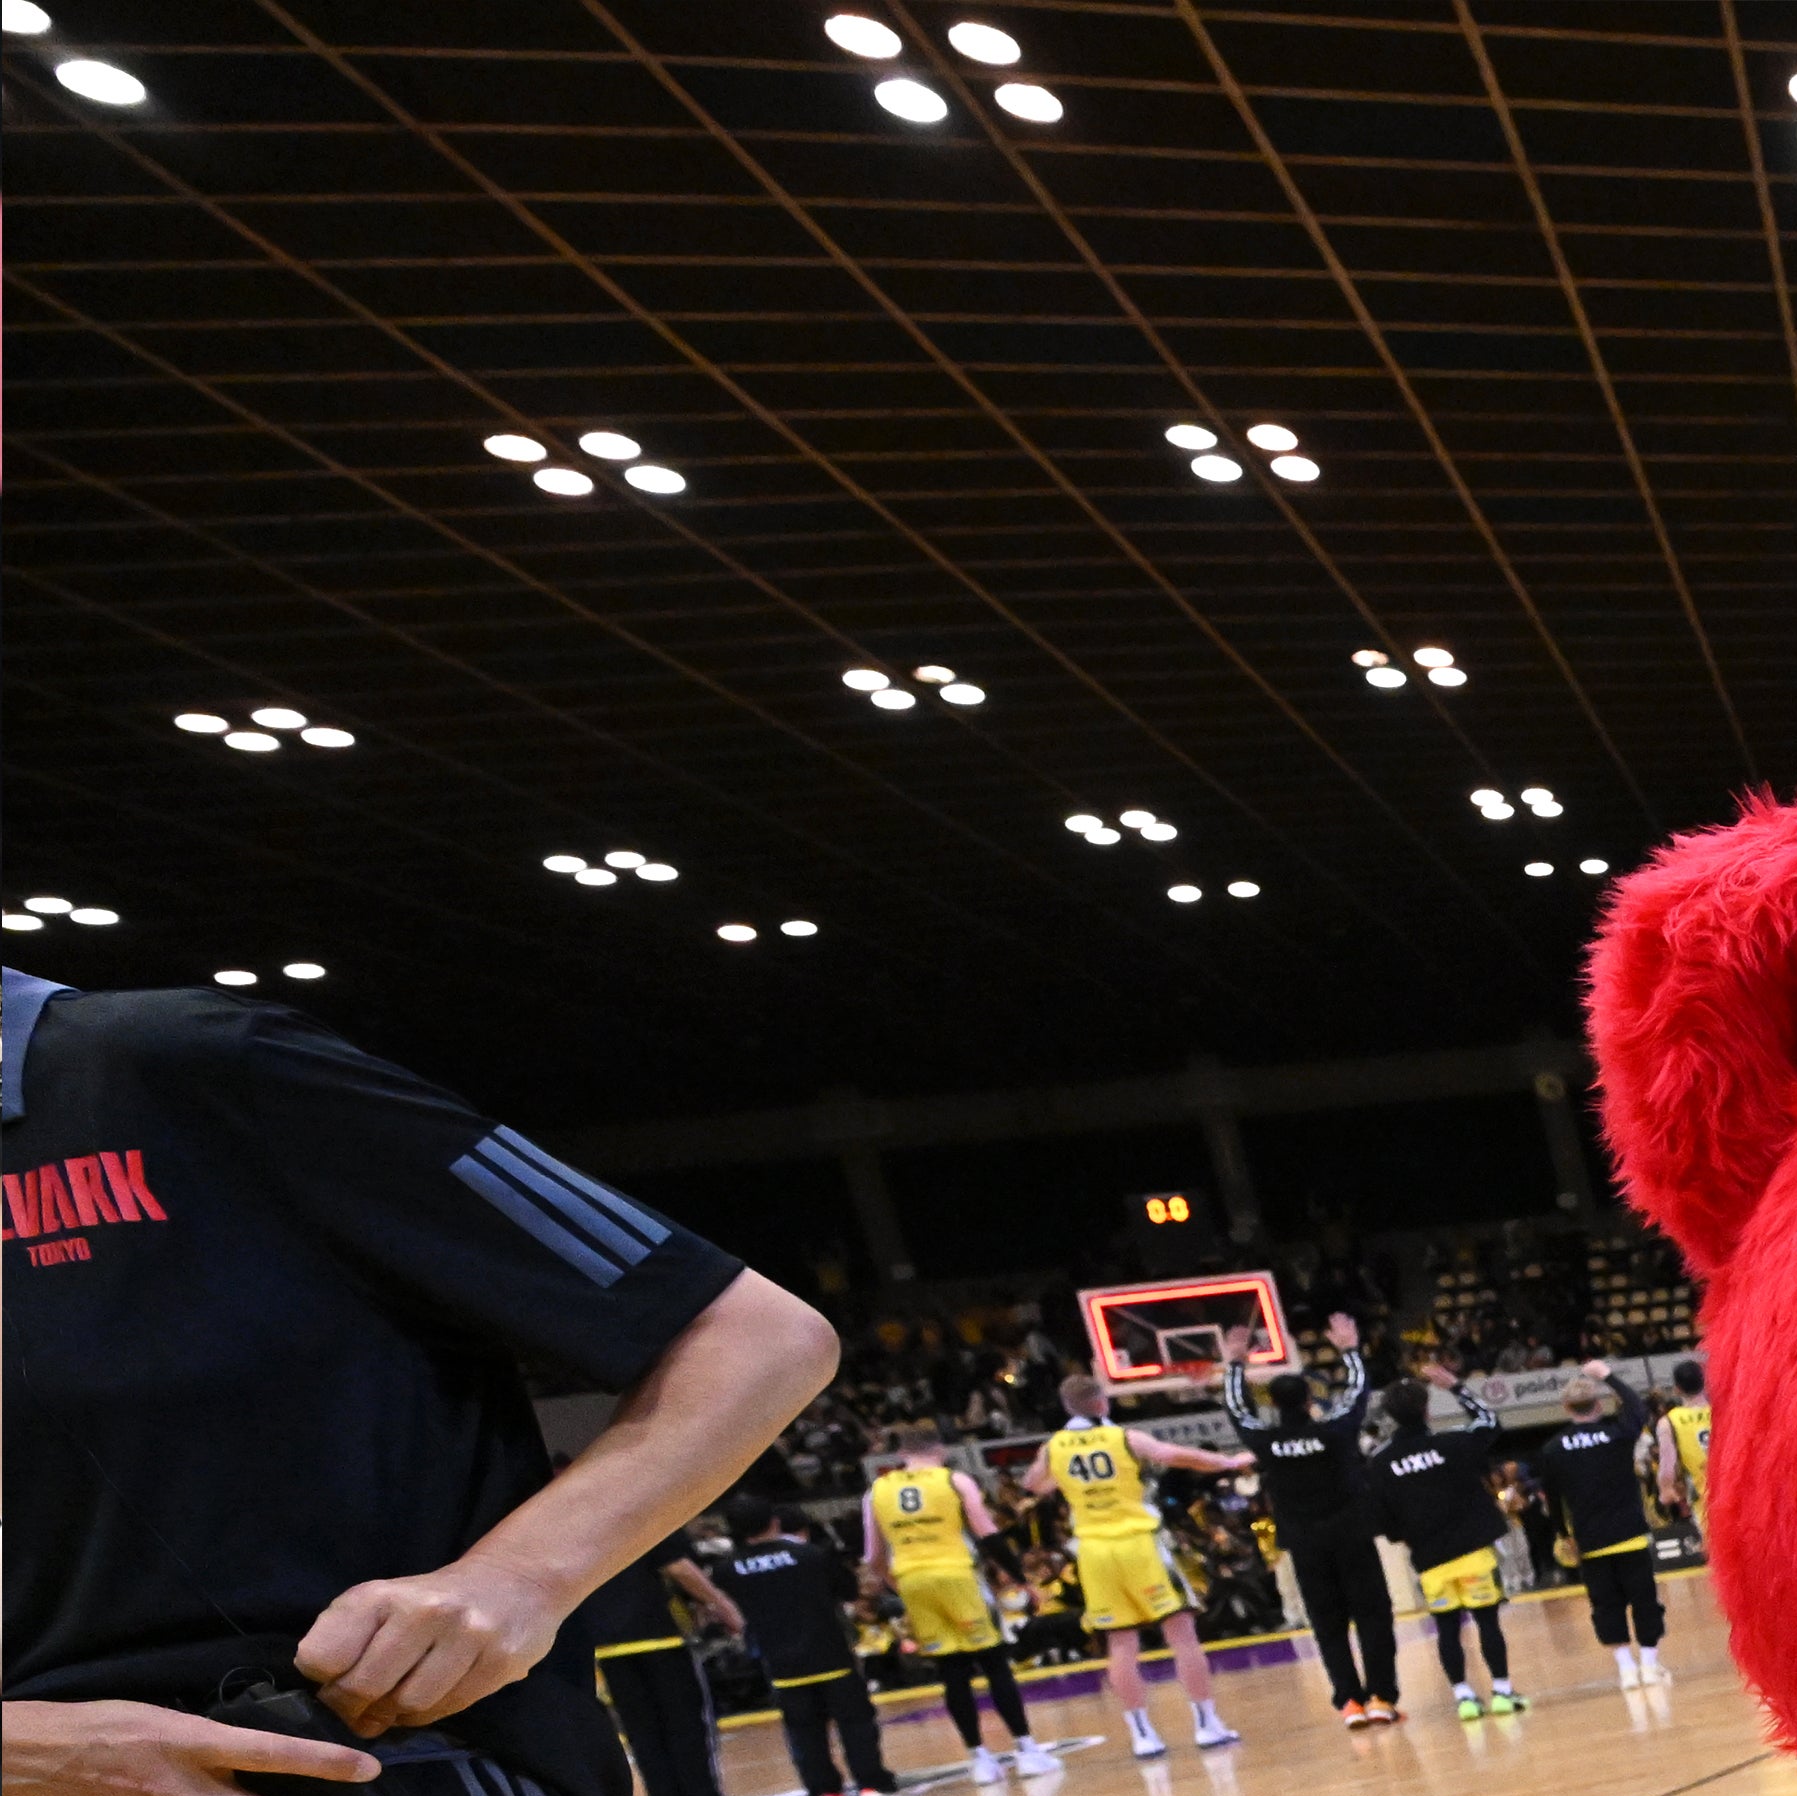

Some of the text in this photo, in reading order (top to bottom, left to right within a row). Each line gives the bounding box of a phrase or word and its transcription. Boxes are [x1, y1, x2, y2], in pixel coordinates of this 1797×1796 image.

[27, 1237, 92, 1268] TOKYO
[1068, 1450, 1116, 1482] 40
[900, 1485, 923, 1513] 8
